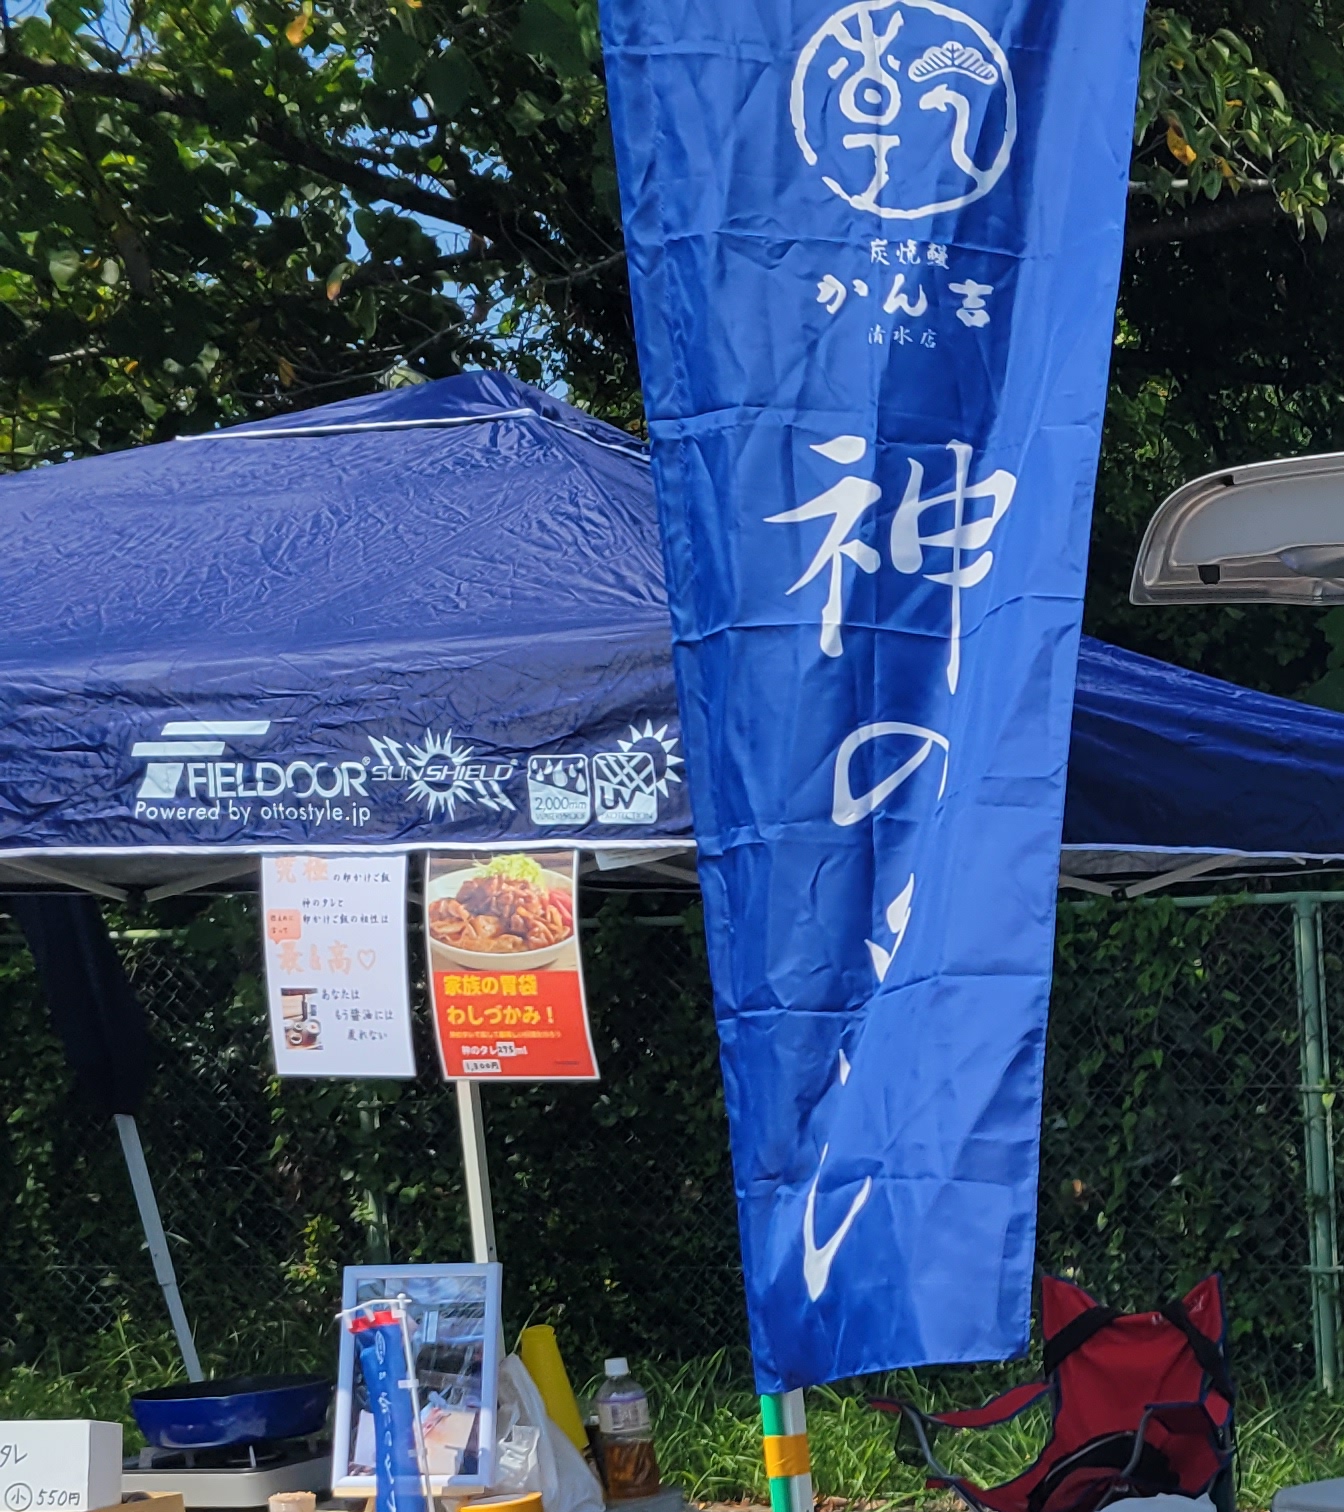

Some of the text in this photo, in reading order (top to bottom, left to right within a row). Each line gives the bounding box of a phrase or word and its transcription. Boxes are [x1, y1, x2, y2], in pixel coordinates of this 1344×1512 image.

[816, 273, 995, 328] かん吉
[868, 323, 938, 349] 清水店
[187, 761, 370, 798] FIELDOOR
[370, 764, 514, 782] SUNSHIELD
[599, 786, 638, 810] UV
[134, 799, 371, 827] Powered by ottostyle.jp
[443, 974, 539, 997] 家族の胃袋
[36, 1488, 81, 1507] 550円
